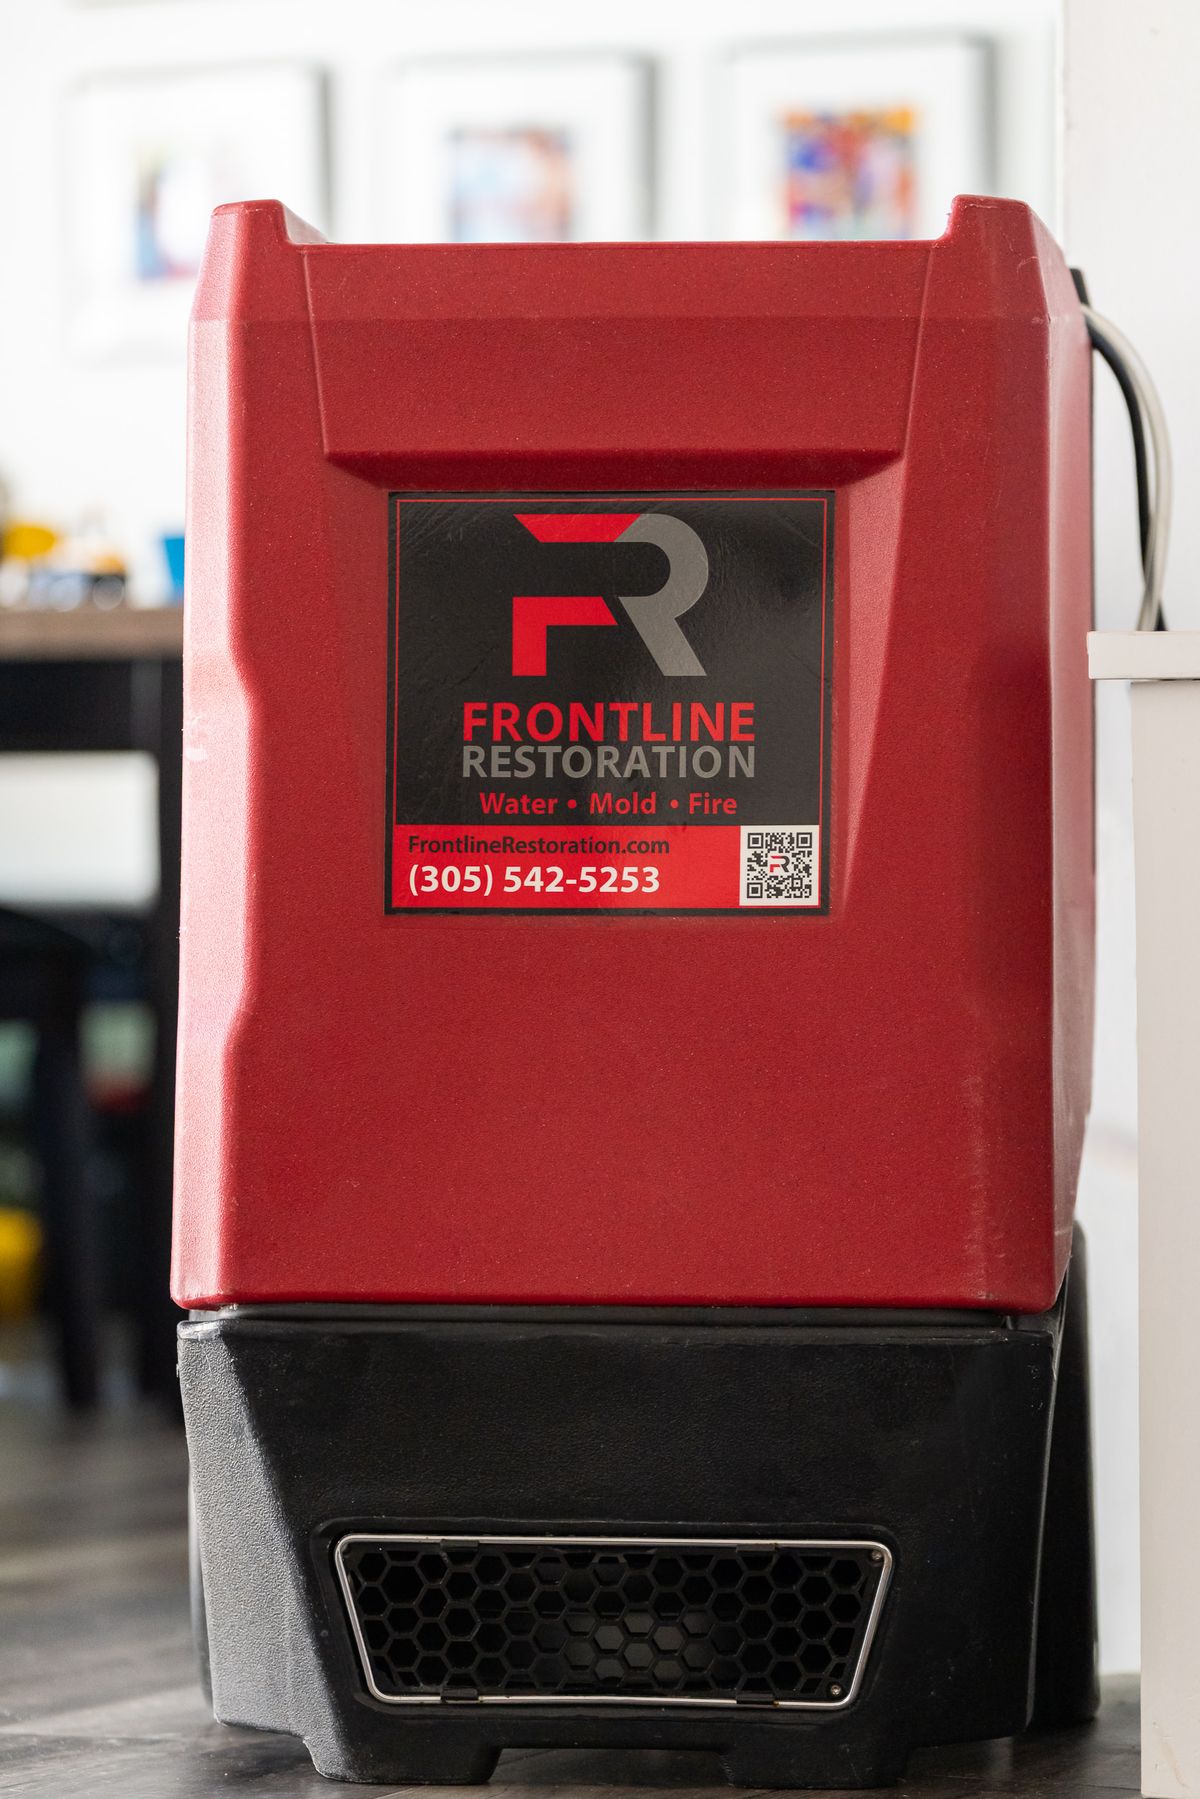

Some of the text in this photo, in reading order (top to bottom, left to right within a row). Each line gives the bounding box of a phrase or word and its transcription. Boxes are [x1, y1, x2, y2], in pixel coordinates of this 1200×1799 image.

[463, 702, 756, 742] FRONTLINE
[462, 745, 756, 779] RESTORATION
[479, 791, 738, 815] Water Mold Fire
[408, 835, 671, 855] FrontlineRestoration.com
[408, 864, 661, 897] (305) 542-5253
